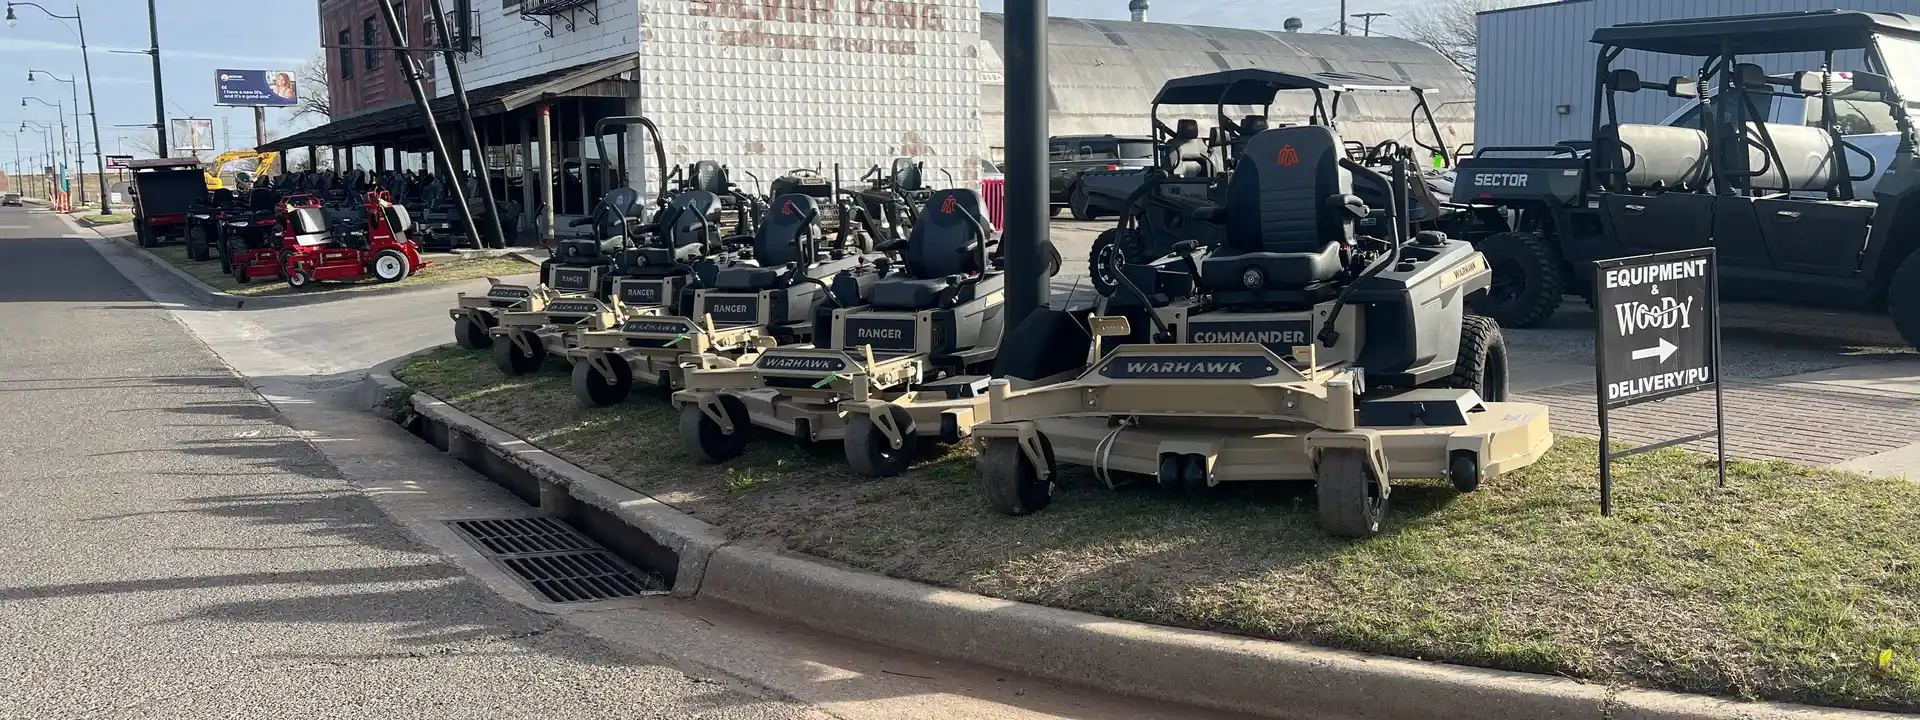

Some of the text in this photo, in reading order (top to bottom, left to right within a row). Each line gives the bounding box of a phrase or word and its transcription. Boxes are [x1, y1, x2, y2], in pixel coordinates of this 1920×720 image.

[1474, 173, 1529, 187] SECTOR
[561, 275, 584, 284] RANGER
[1606, 258, 1707, 289] EQUIPMENT
[627, 288, 655, 297] RANGER
[1650, 284, 1660, 295] &
[713, 304, 748, 313] RANGER
[857, 327, 902, 339] RANGER
[1193, 330, 1305, 344] COMMANDER
[766, 357, 832, 369] WARHAWK
[1127, 361, 1244, 373] WARHAWK
[1608, 366, 1709, 400] DELIVERY/PU
